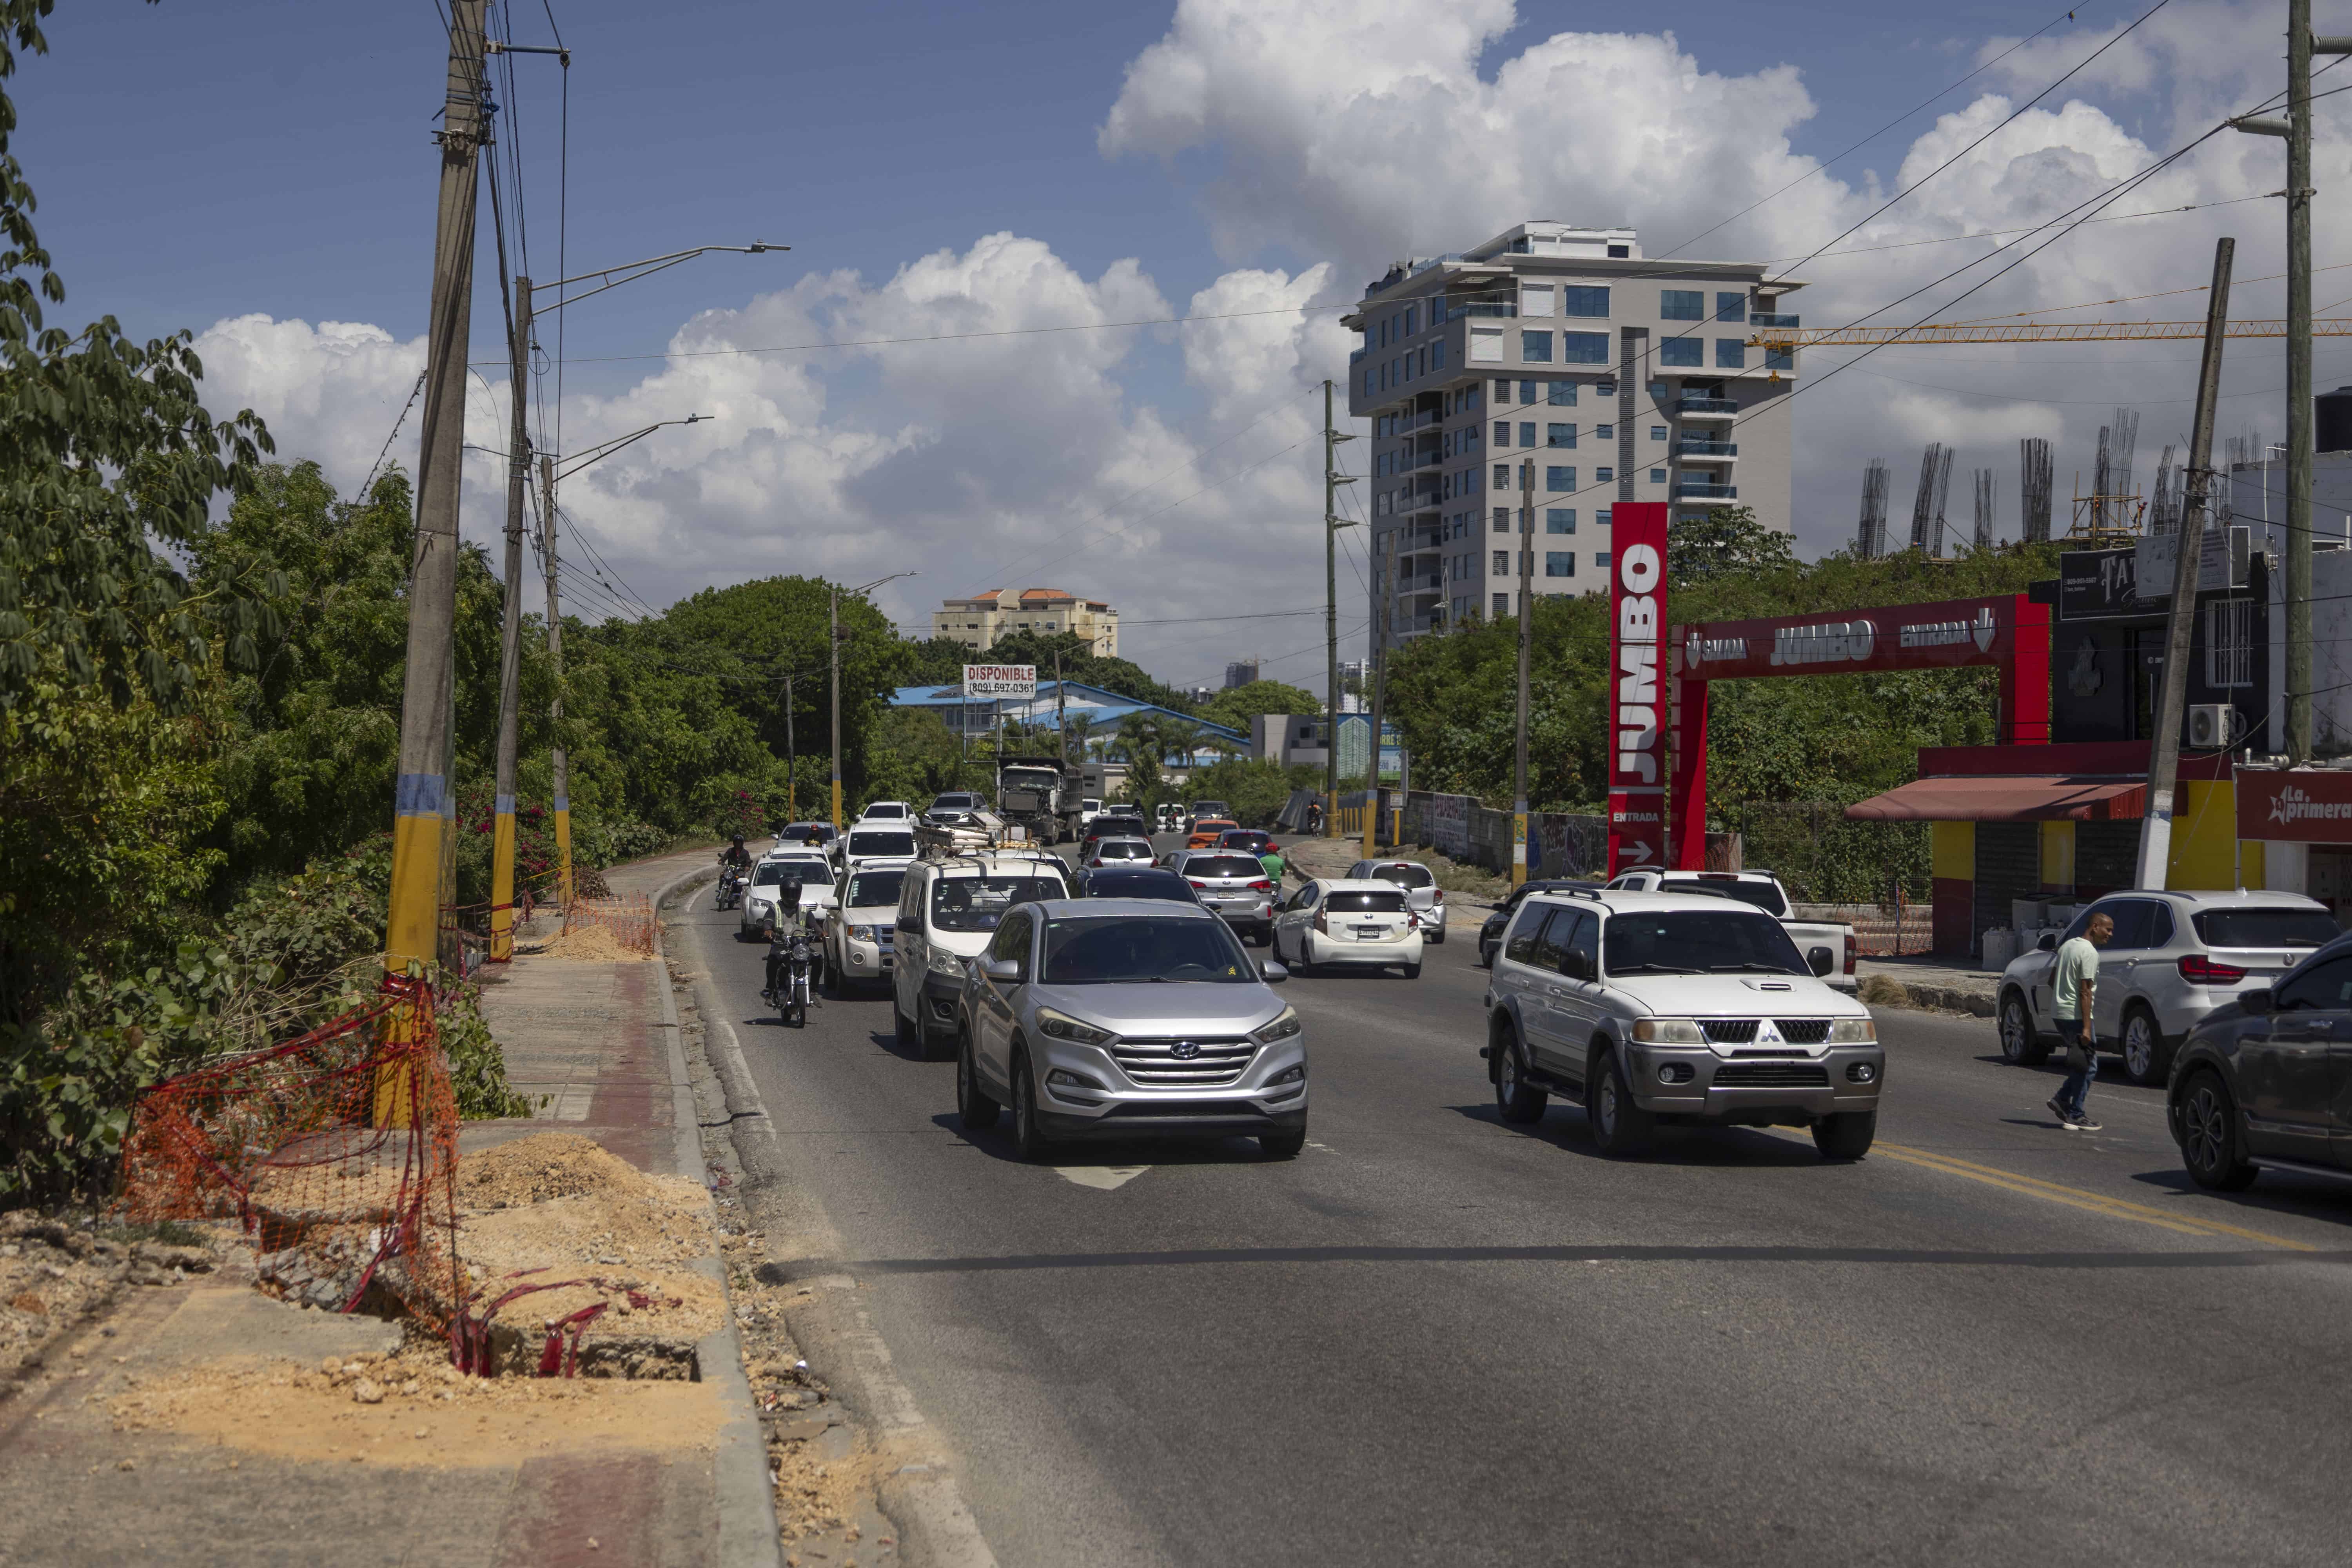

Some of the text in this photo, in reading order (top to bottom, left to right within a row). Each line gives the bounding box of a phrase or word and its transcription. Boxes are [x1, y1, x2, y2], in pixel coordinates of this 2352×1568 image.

[1770, 620, 1875, 666] JUMBO
[1900, 621, 1971, 648] ENTRADA
[1702, 639, 1747, 661] SALIDA
[969, 667, 1034, 681] DISPONIBLE
[1619, 544, 1659, 783] JUMBO
[969, 682, 1034, 694] (809) 697-0361
[2287, 785, 2303, 801] La
[1613, 812, 1659, 822] ENTRADA
[2286, 796, 2352, 822] primera
